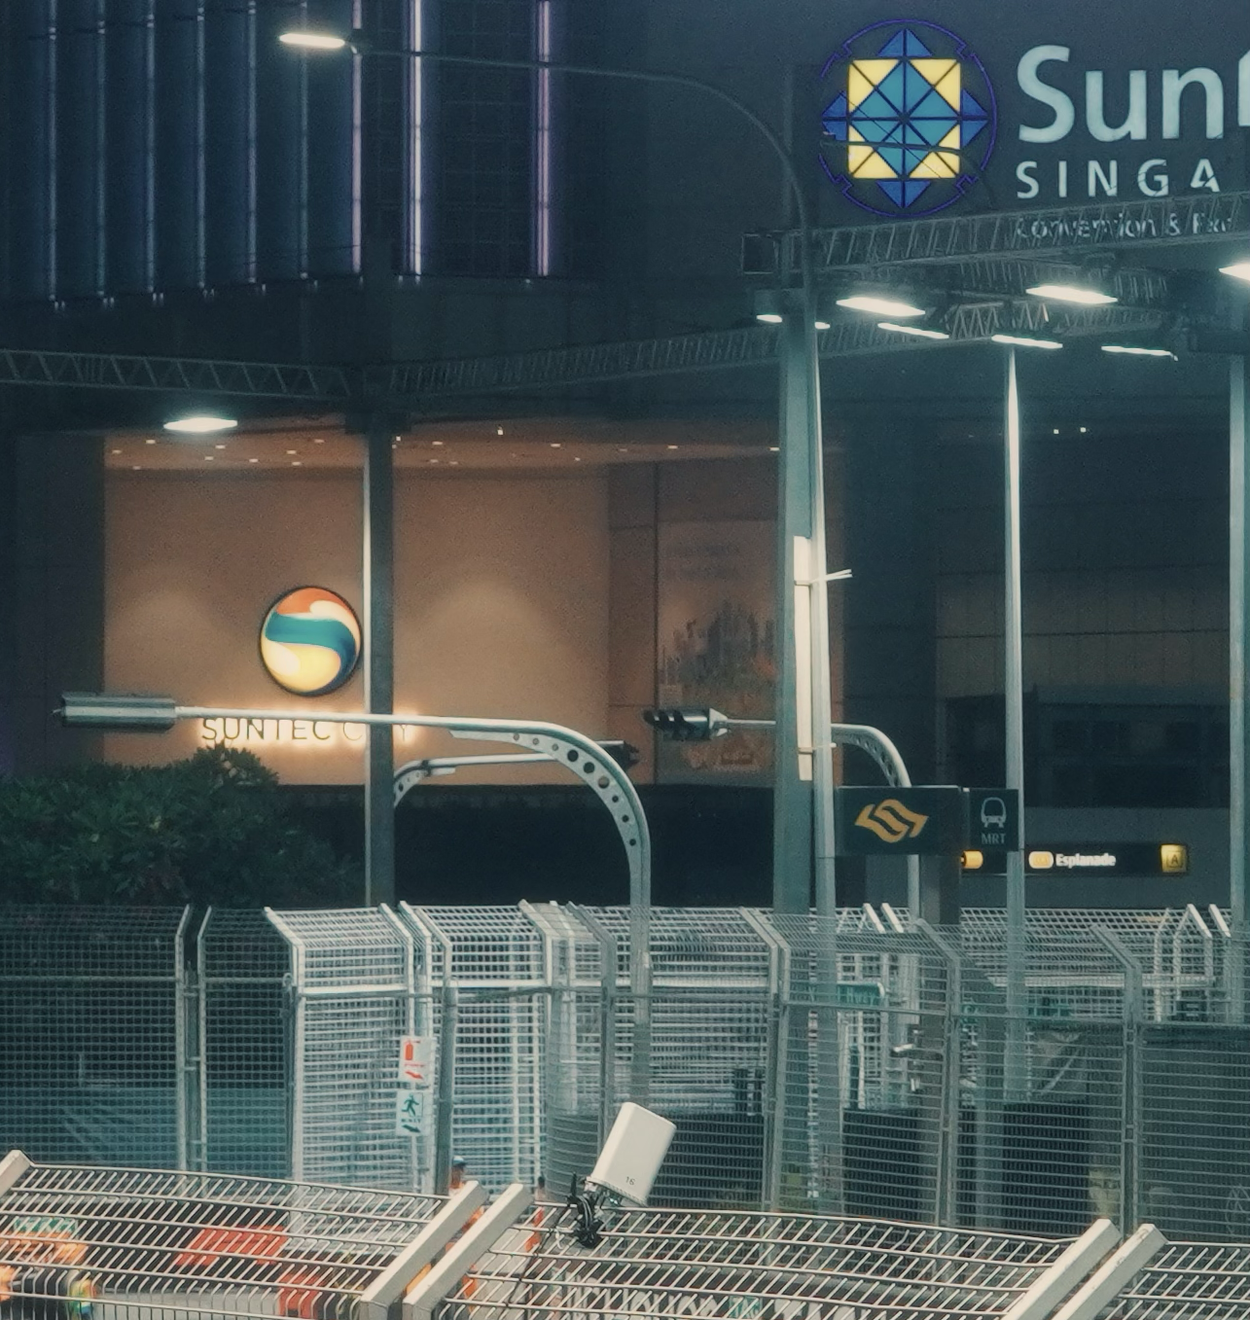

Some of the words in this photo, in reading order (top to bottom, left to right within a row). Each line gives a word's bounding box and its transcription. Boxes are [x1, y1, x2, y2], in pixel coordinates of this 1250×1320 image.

[1015, 158, 1221, 200] SINGA
[1165, 212, 1182, 237] &
[201, 717, 331, 741] SUNTEC
[342, 721, 409, 742] CY
[981, 832, 1006, 845] MRT
[1055, 853, 1117, 869] Esplanade
